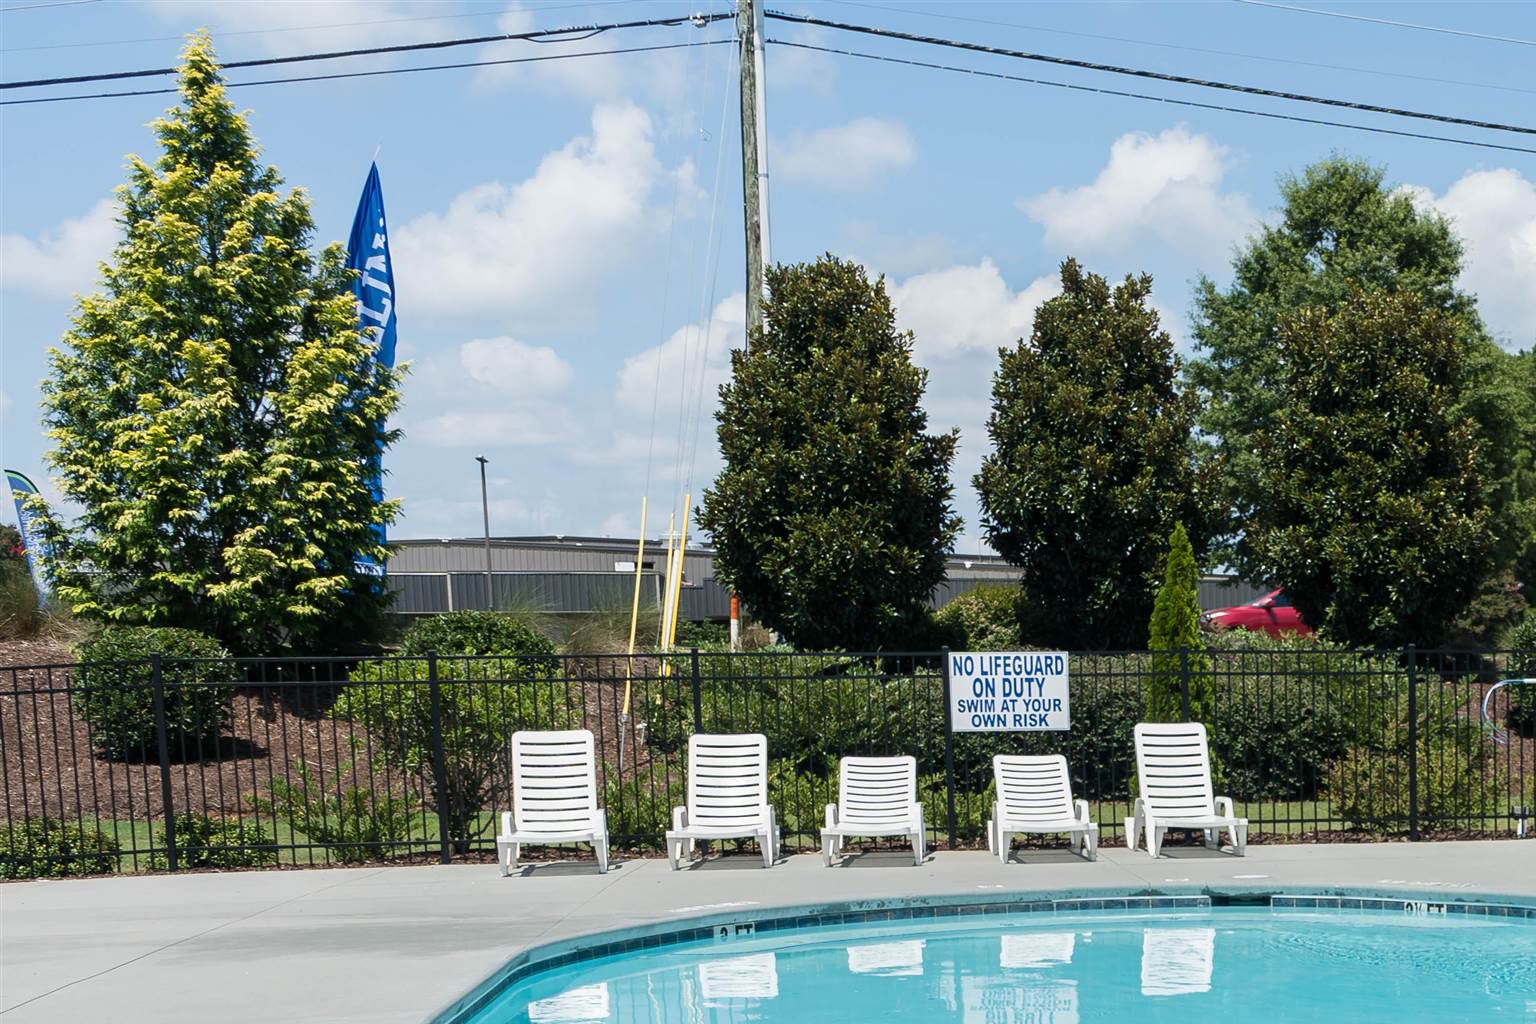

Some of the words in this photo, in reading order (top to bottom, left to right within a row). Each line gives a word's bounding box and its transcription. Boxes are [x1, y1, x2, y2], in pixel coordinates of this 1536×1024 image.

[952, 655, 974, 676] NO
[980, 655, 1064, 676] LIFEGUARD
[972, 677, 996, 698] ON
[1002, 677, 1045, 698] DUTY
[958, 699, 995, 713] SWIM
[1001, 699, 1018, 713] AT
[1023, 698, 1062, 712] YOUR
[971, 714, 1007, 727] OWN
[1013, 713, 1049, 727] RISK
